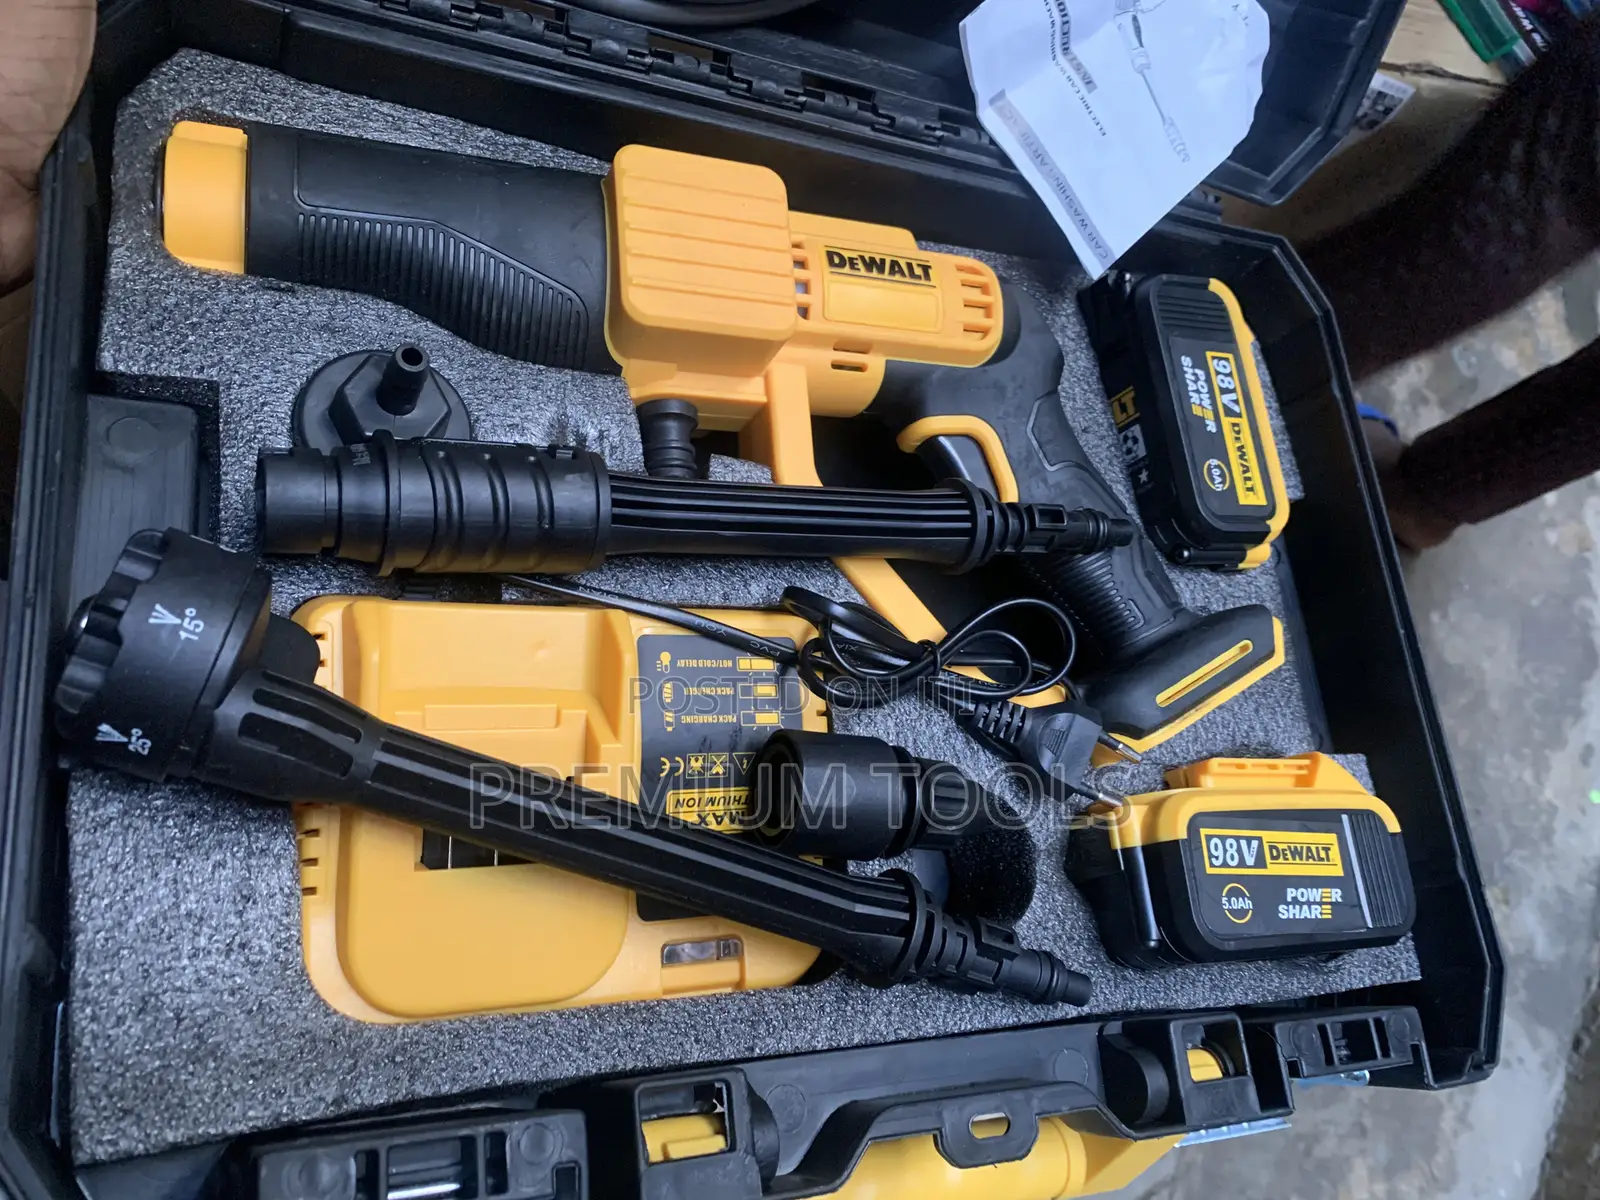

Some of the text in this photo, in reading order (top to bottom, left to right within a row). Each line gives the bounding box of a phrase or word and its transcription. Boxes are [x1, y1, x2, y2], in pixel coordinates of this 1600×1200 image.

[1055, 0, 1094, 86] INSTRUCTIO
[1066, 75, 1080, 94] CAR
[1078, 94, 1106, 137] ELECTRIC
[1088, 231, 1108, 260] CAR
[1180, 354, 1204, 418] SHARE
[1212, 357, 1242, 414] 98V
[1194, 367, 1218, 434] POWER
[179, 607, 205, 641] 15°
[749, 640, 780, 657] PVC
[676, 659, 698, 668] DELAY
[716, 687, 735, 695] PACK
[680, 714, 737, 724] PACK CHARGING
[674, 794, 750, 809] THIUM ION
[697, 810, 745, 826] MAX
[1208, 837, 1259, 867] 98V
[1221, 887, 1343, 910] 5.0Ah POWER
[1278, 904, 1333, 919] SHARE
